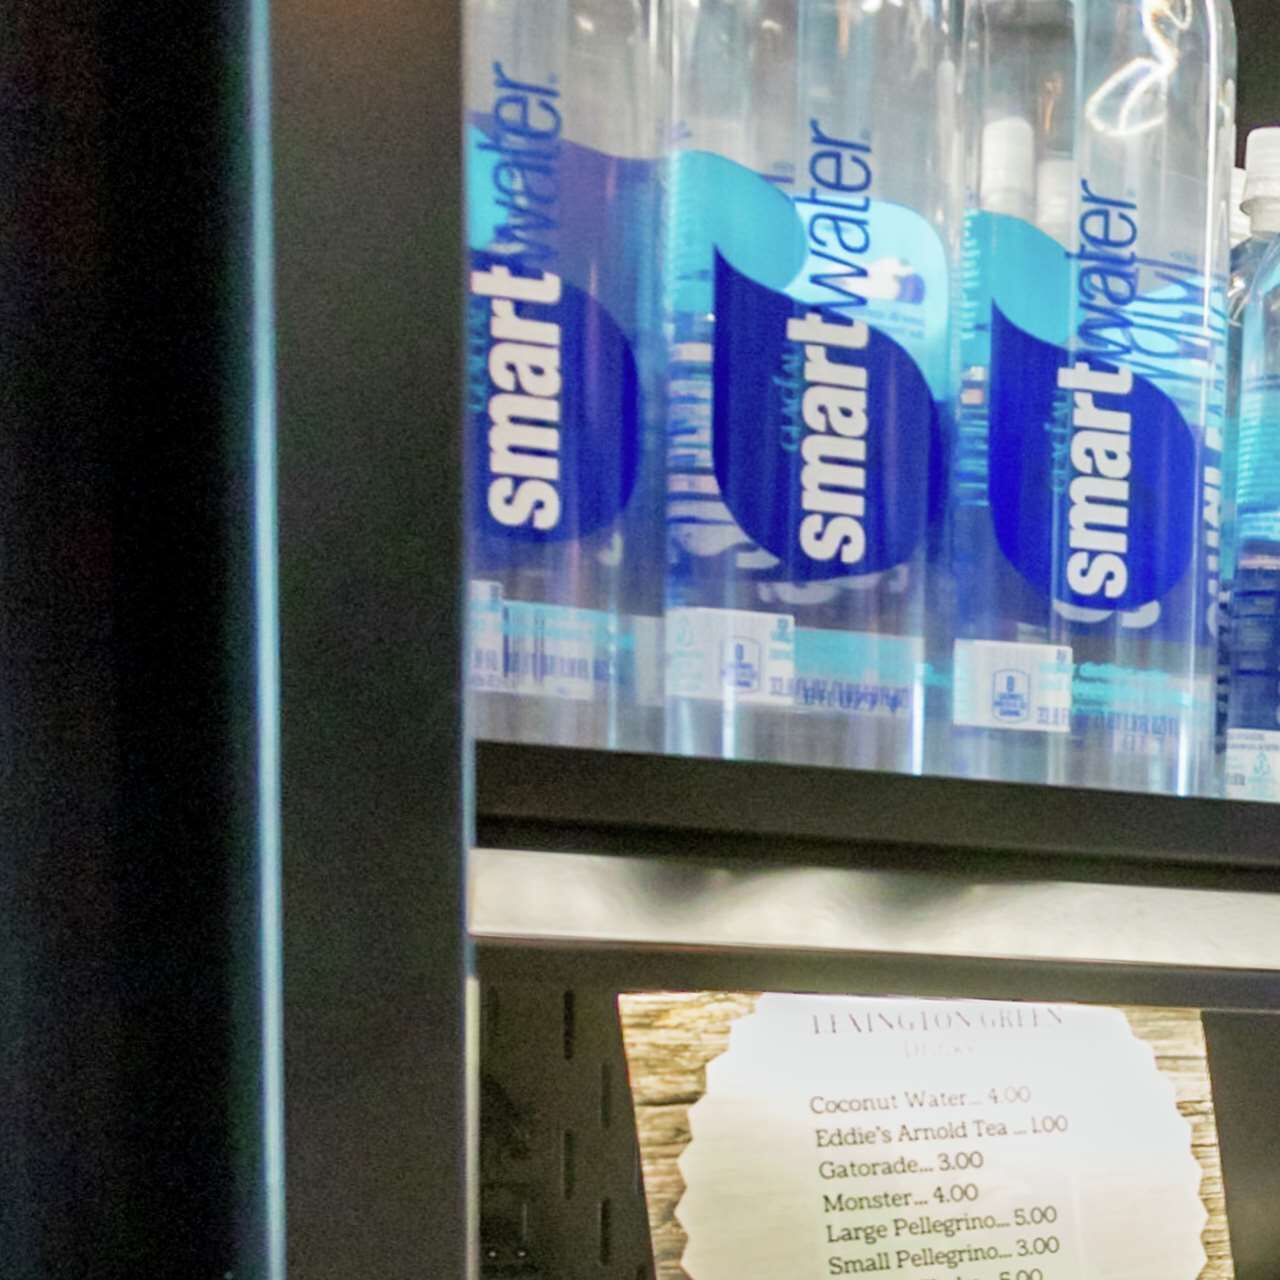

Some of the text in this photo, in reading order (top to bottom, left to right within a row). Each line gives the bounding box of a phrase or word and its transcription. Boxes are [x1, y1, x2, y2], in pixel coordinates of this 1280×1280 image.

[810, 1095, 898, 1114] Coconut
[988, 1086, 1031, 1104] 4.00
[816, 1127, 893, 1148] Eddie's
[899, 1121, 968, 1142] Arnold
[973, 1120, 1008, 1137] Tea
[937, 1150, 983, 1171] 3.00
[933, 1183, 978, 1204] 4.00
[826, 1224, 888, 1245] Large
[1014, 1205, 1057, 1226] 5.00
[829, 1252, 891, 1275] Small
[1016, 1236, 1060, 1258] 3.00
